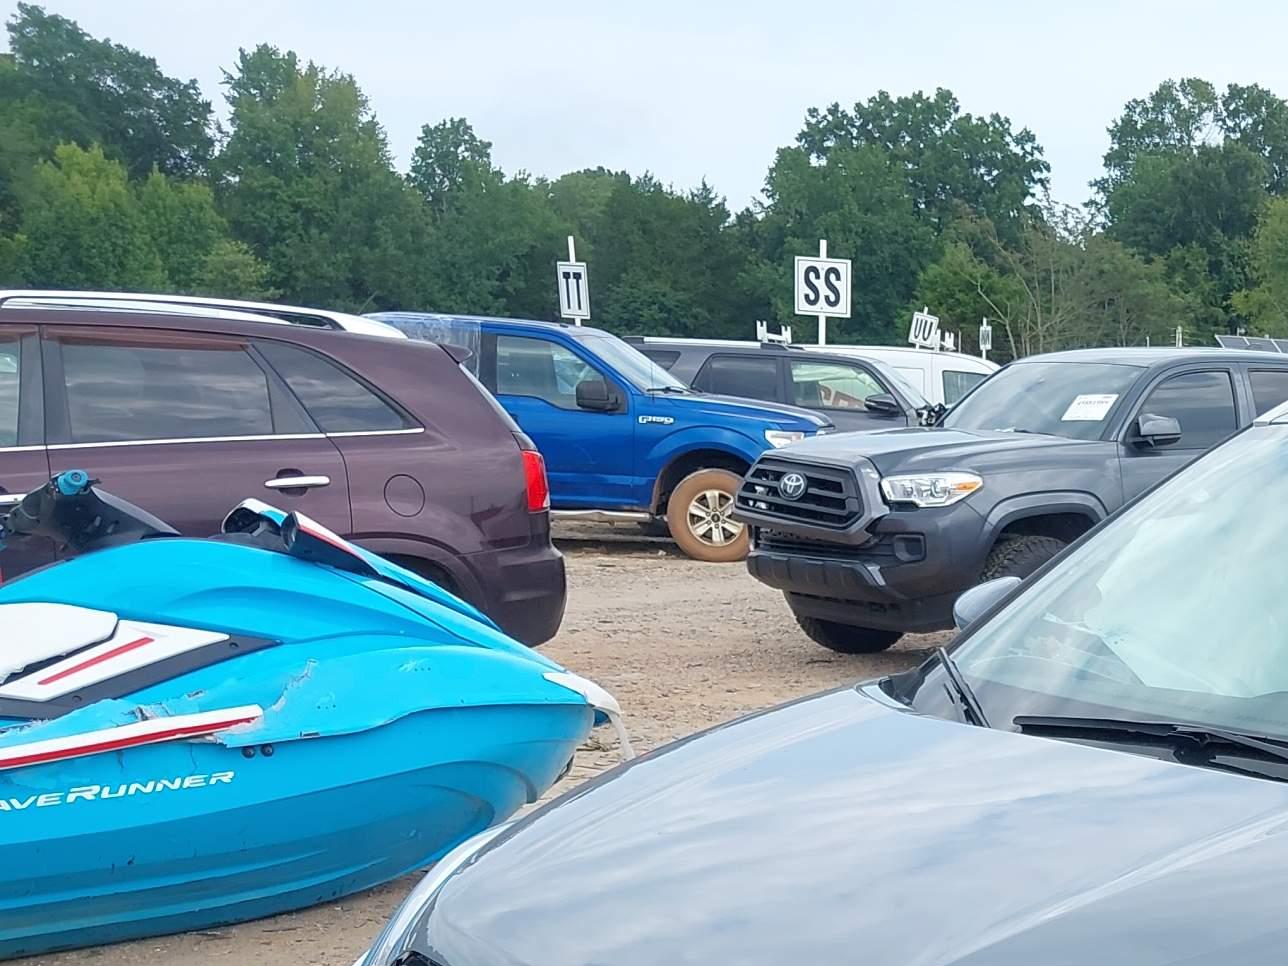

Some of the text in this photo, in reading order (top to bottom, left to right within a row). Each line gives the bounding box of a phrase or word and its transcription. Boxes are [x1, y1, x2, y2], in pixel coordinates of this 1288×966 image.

[562, 271, 582, 310] TT
[804, 265, 841, 308] SS
[913, 317, 934, 341] UU
